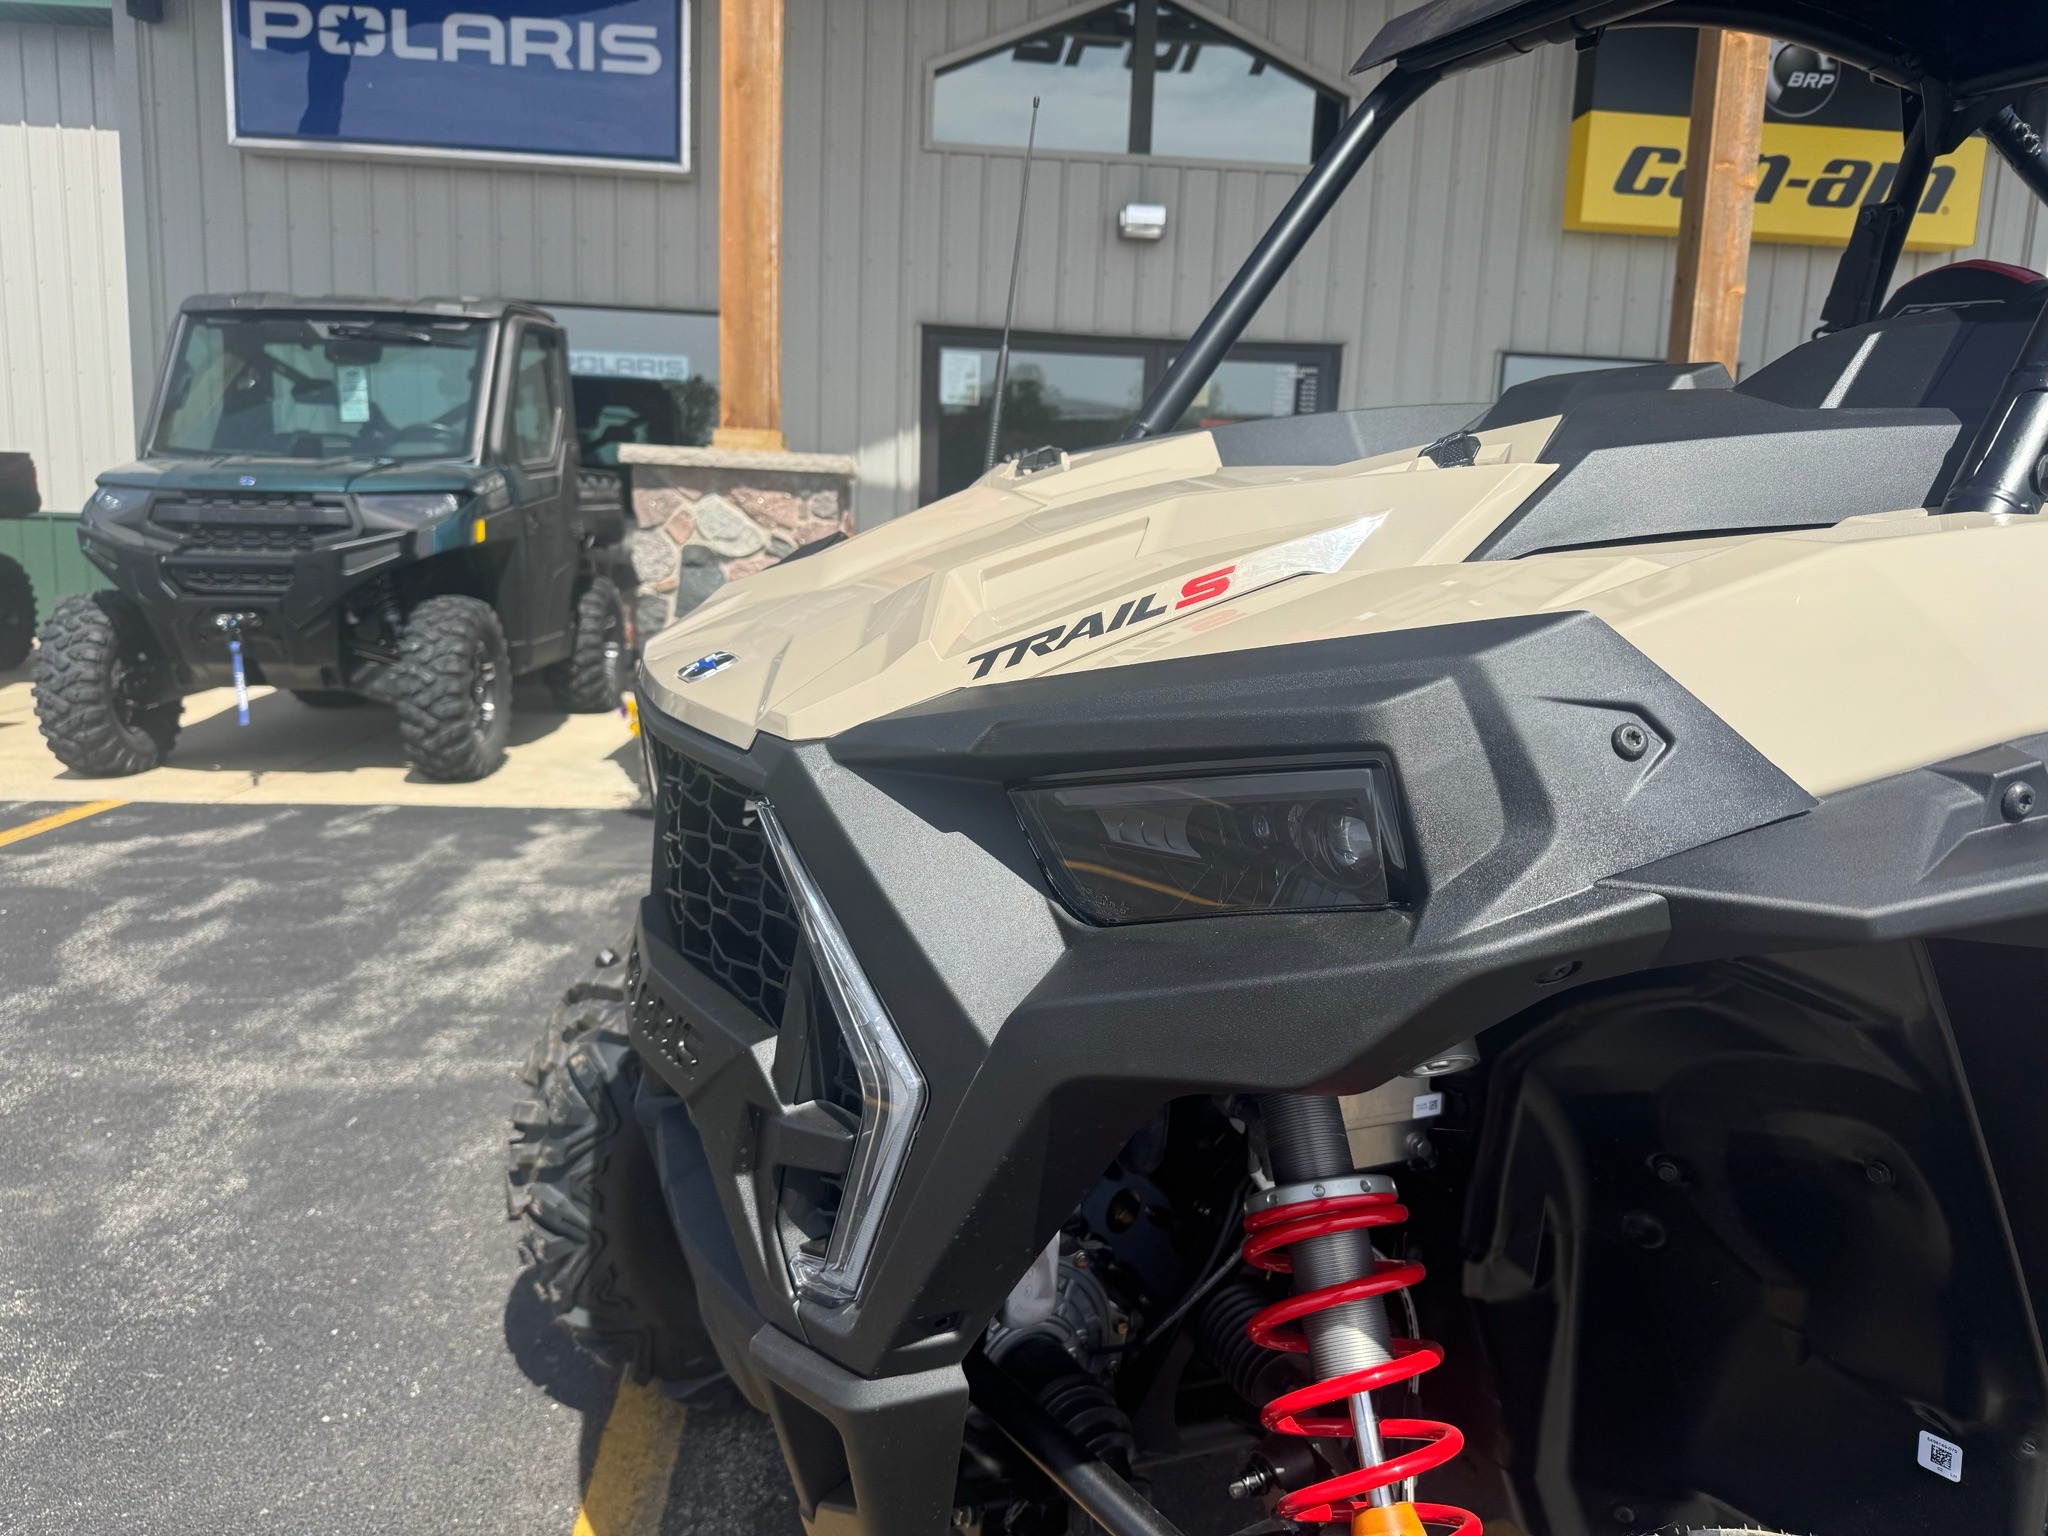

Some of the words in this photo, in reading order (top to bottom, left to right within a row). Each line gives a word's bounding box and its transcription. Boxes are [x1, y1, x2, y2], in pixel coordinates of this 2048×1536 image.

[249, 1, 664, 76] POLARIS
[1787, 71, 1836, 89] BRP
[569, 355, 685, 377] OLARIS
[967, 592, 1169, 681] TRAIL
